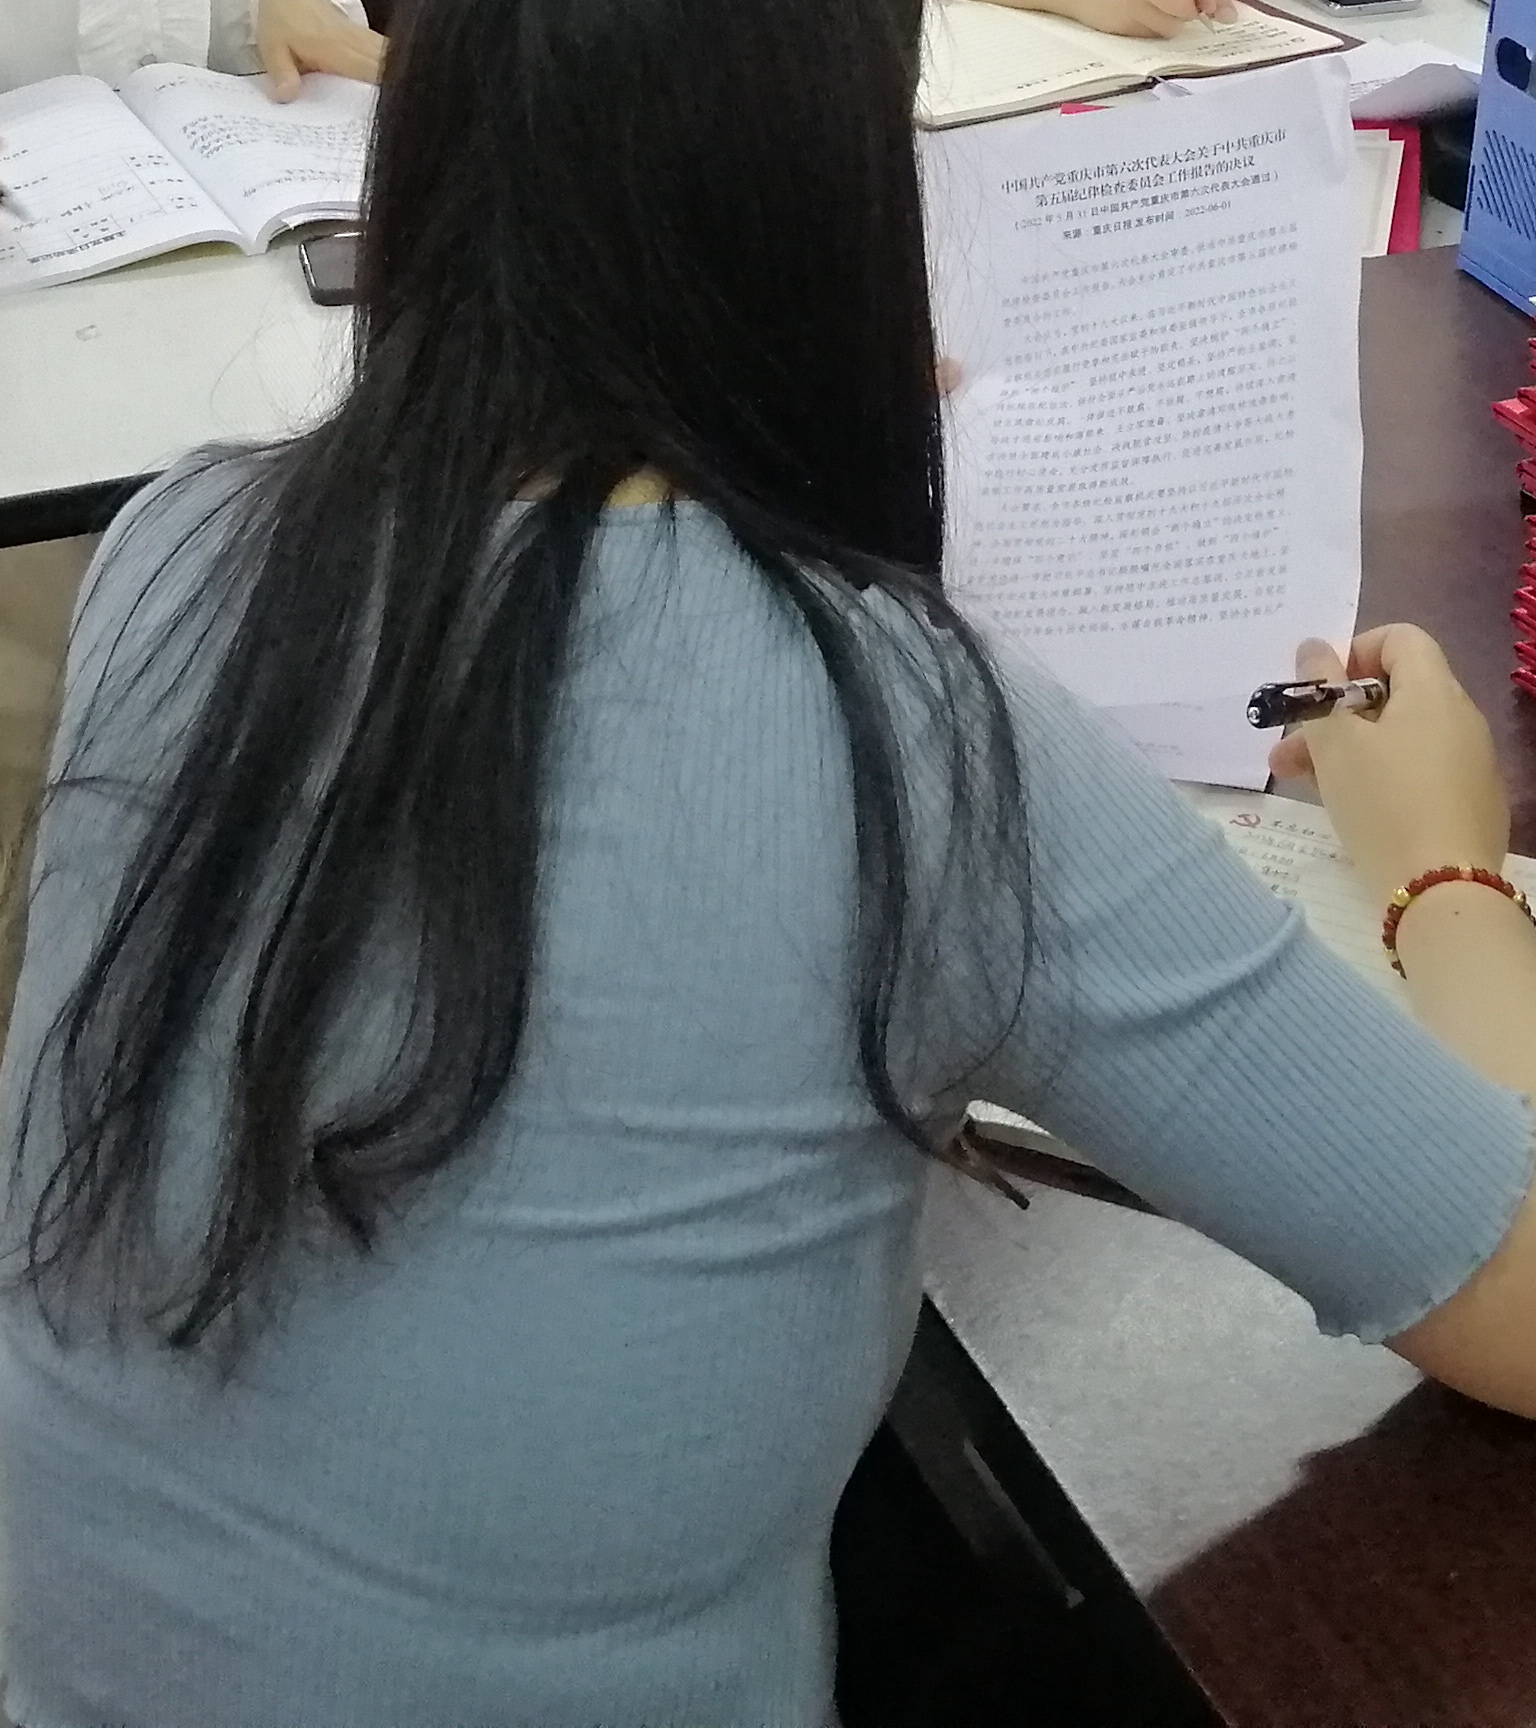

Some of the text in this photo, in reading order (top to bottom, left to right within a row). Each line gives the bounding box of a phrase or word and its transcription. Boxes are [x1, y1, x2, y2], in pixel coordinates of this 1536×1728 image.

[1001, 128, 1287, 194] 中国共产党重庆市第六次代表大会关于中共重庆市
[1036, 155, 1256, 208] 第五届纪律检查委员会工作报告的决议
